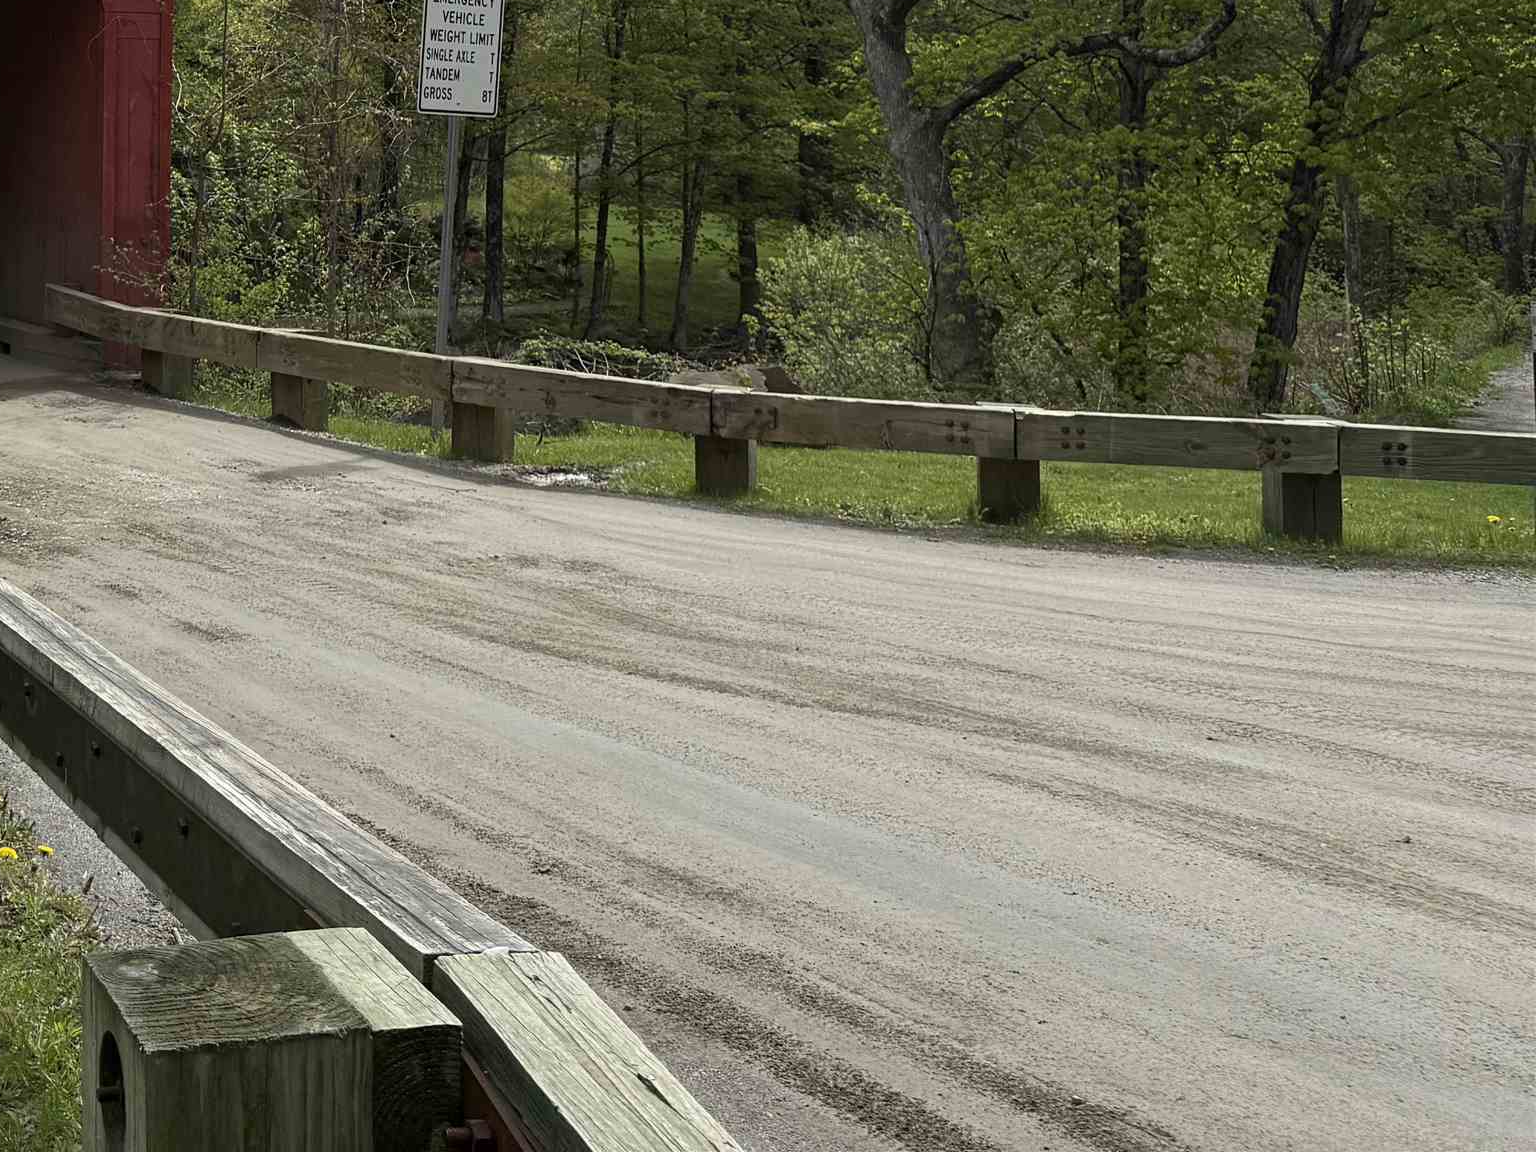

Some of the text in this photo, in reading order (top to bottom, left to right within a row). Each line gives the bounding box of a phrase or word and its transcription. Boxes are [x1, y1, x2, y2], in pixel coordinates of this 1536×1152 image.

[442, 10, 486, 26] VEHICLE
[430, 28, 495, 46] WEIGHT LIMIT
[426, 47, 496, 65] SINGLE AXLE T
[425, 66, 495, 84] TANDEM T
[423, 86, 493, 104] GROSS 8T
